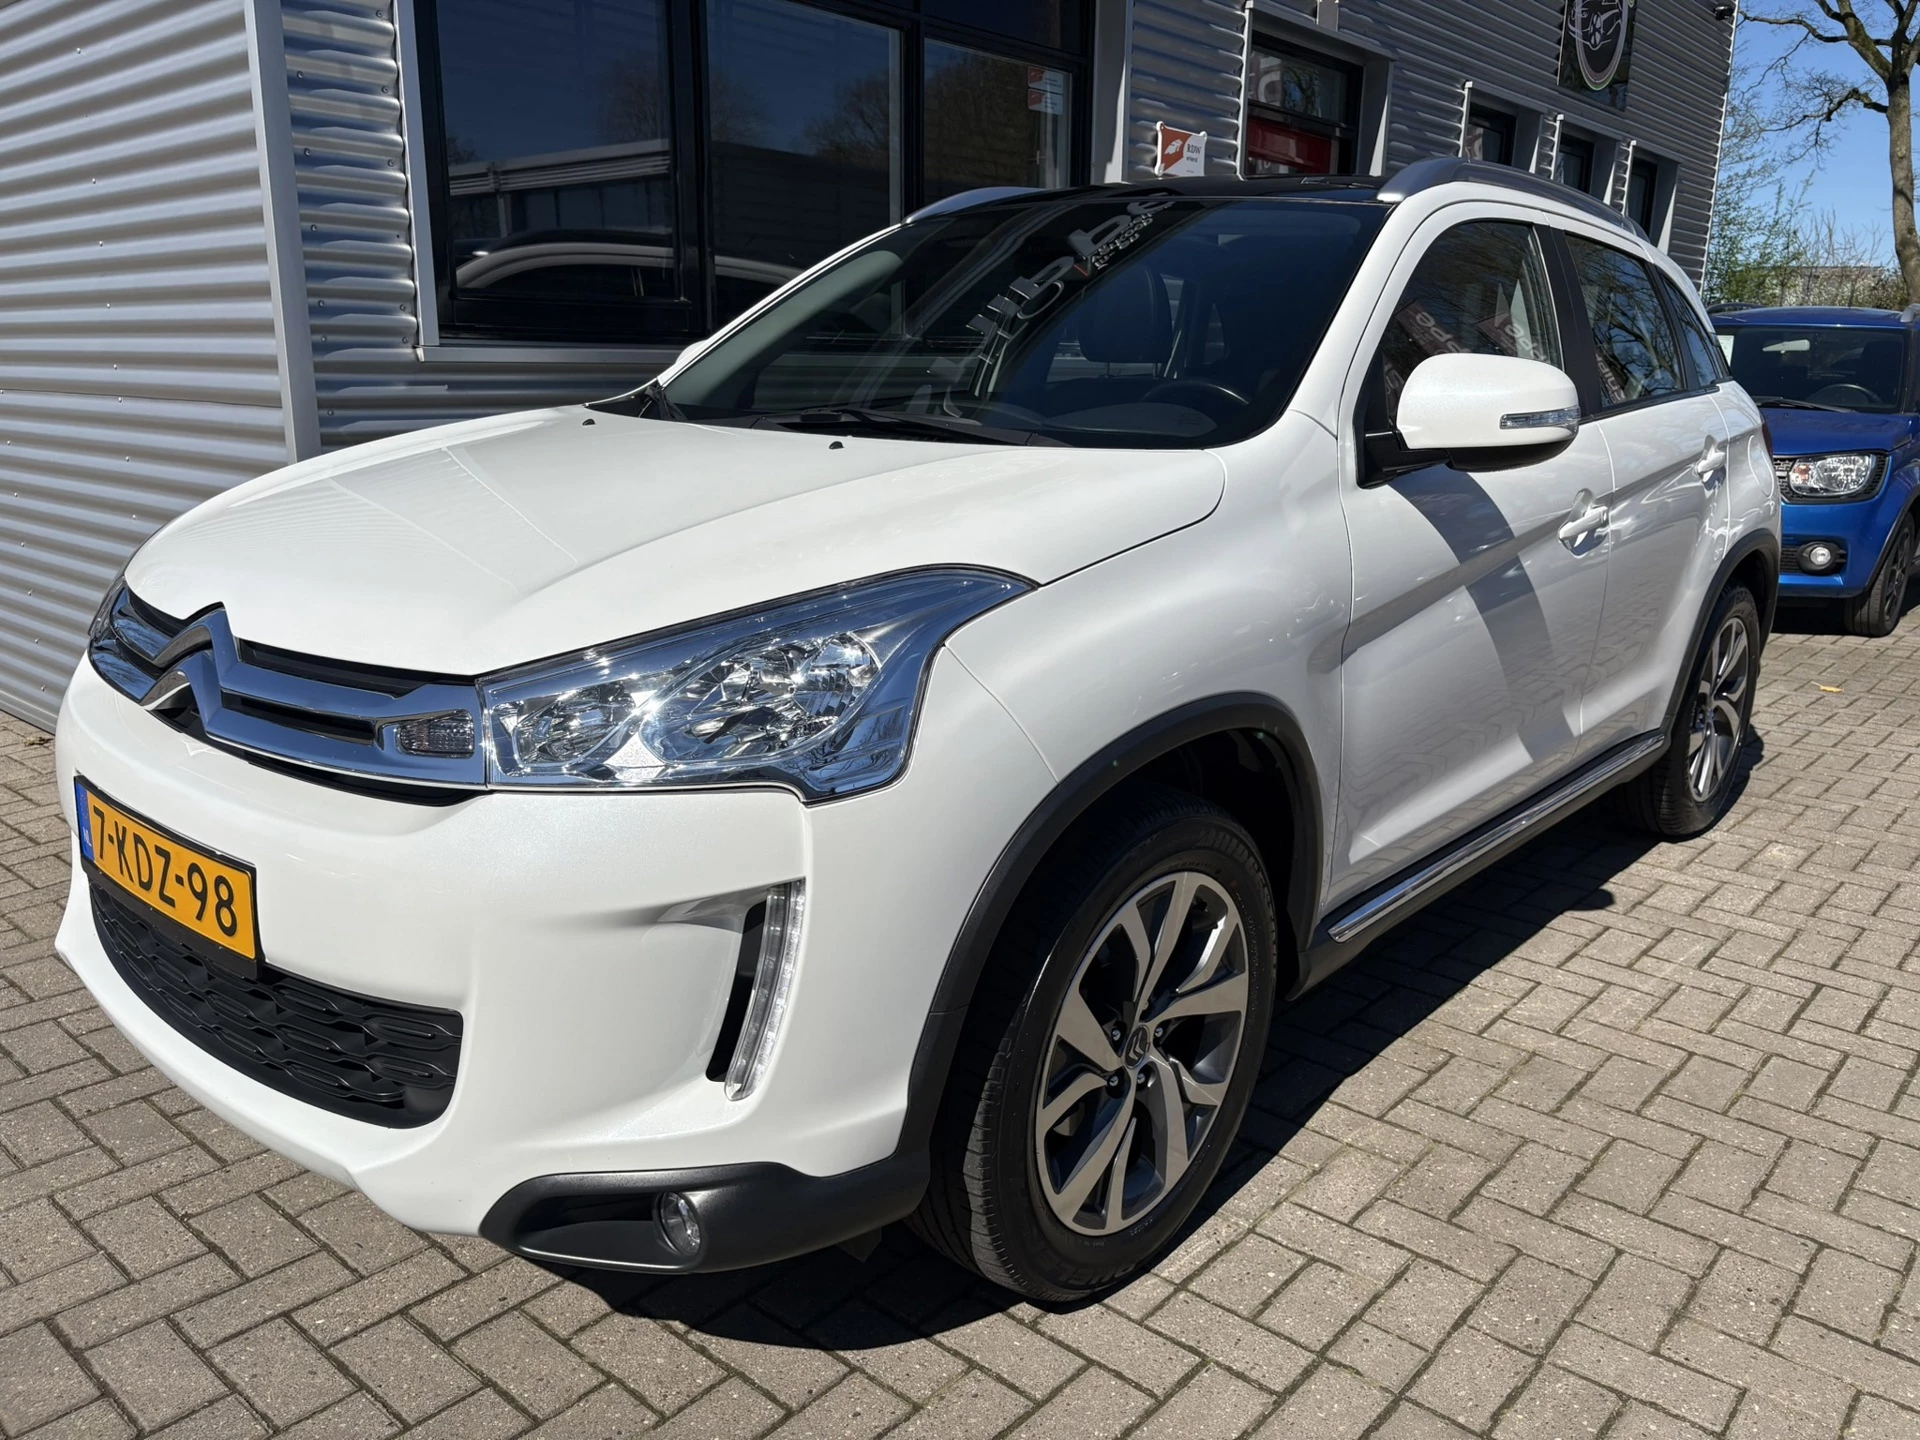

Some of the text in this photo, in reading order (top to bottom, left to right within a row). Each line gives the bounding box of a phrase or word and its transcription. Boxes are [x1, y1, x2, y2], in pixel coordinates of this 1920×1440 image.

[1187, 143, 1201, 155] RDW
[82, 826, 93, 847] NL
[93, 805, 237, 937] 7-KDZ-98
